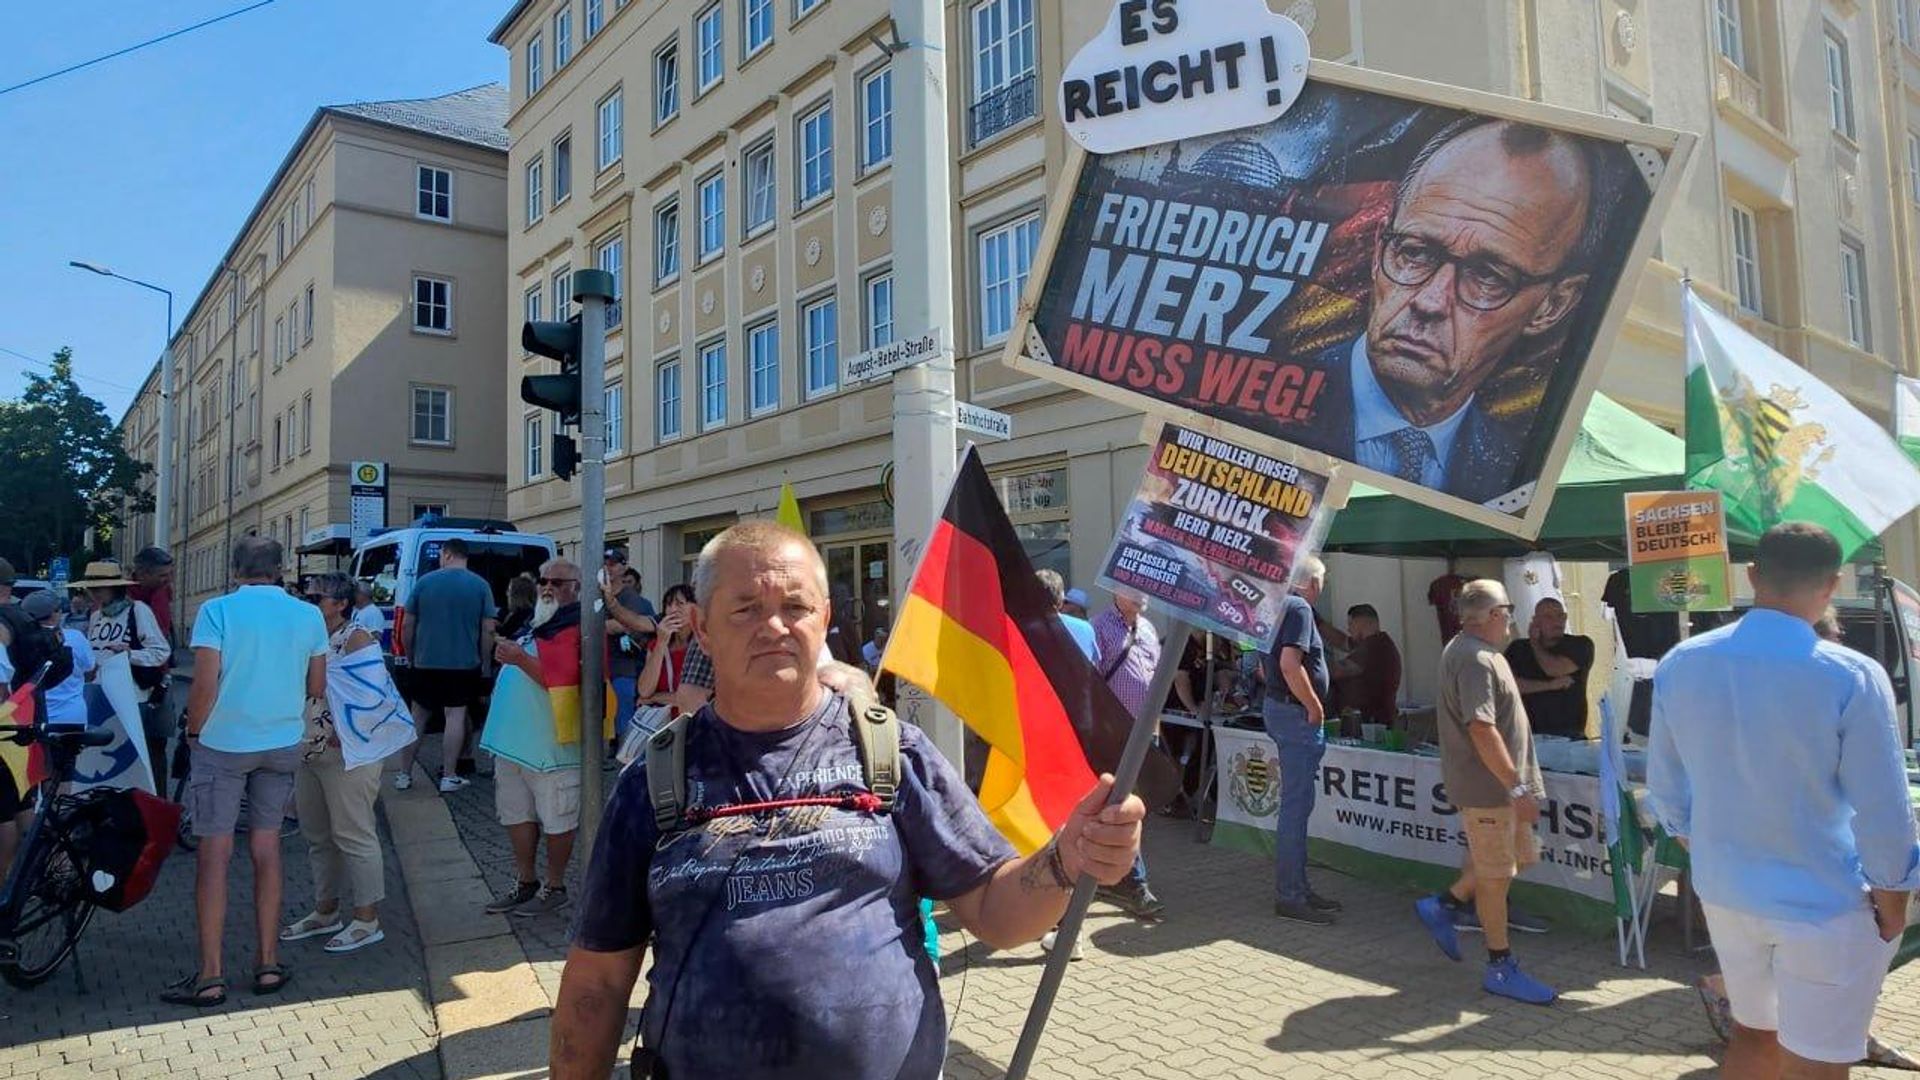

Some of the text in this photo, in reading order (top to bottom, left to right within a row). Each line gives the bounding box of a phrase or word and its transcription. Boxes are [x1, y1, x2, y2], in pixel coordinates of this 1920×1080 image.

[1120, 0, 1178, 46] ES
[1091, 192, 1329, 276] FRIEDRICH
[1071, 247, 1295, 354] MERZ
[847, 335, 934, 378] August-Bebel-Straße
[1062, 324, 1326, 421] MUSS WEG!
[1177, 429, 1299, 482] WIR WOLLEN UNSER
[1159, 442, 1313, 518] DEUTSCHLAND
[1171, 479, 1270, 536] ZURÜCK.
[1636, 501, 1715, 523] SACHSEN
[1174, 512, 1252, 555] HERR MERZ,
[1636, 521, 1689, 538] BLEIBT
[1637, 532, 1716, 552] DEUTSCH!
[1117, 558, 1177, 585] ALLE MINISTER
[1122, 547, 1183, 574] ENTLASSEN SIE
[1231, 579, 1260, 600] CDU
[1218, 601, 1243, 624] SPD
[727, 869, 815, 910] JEANS
